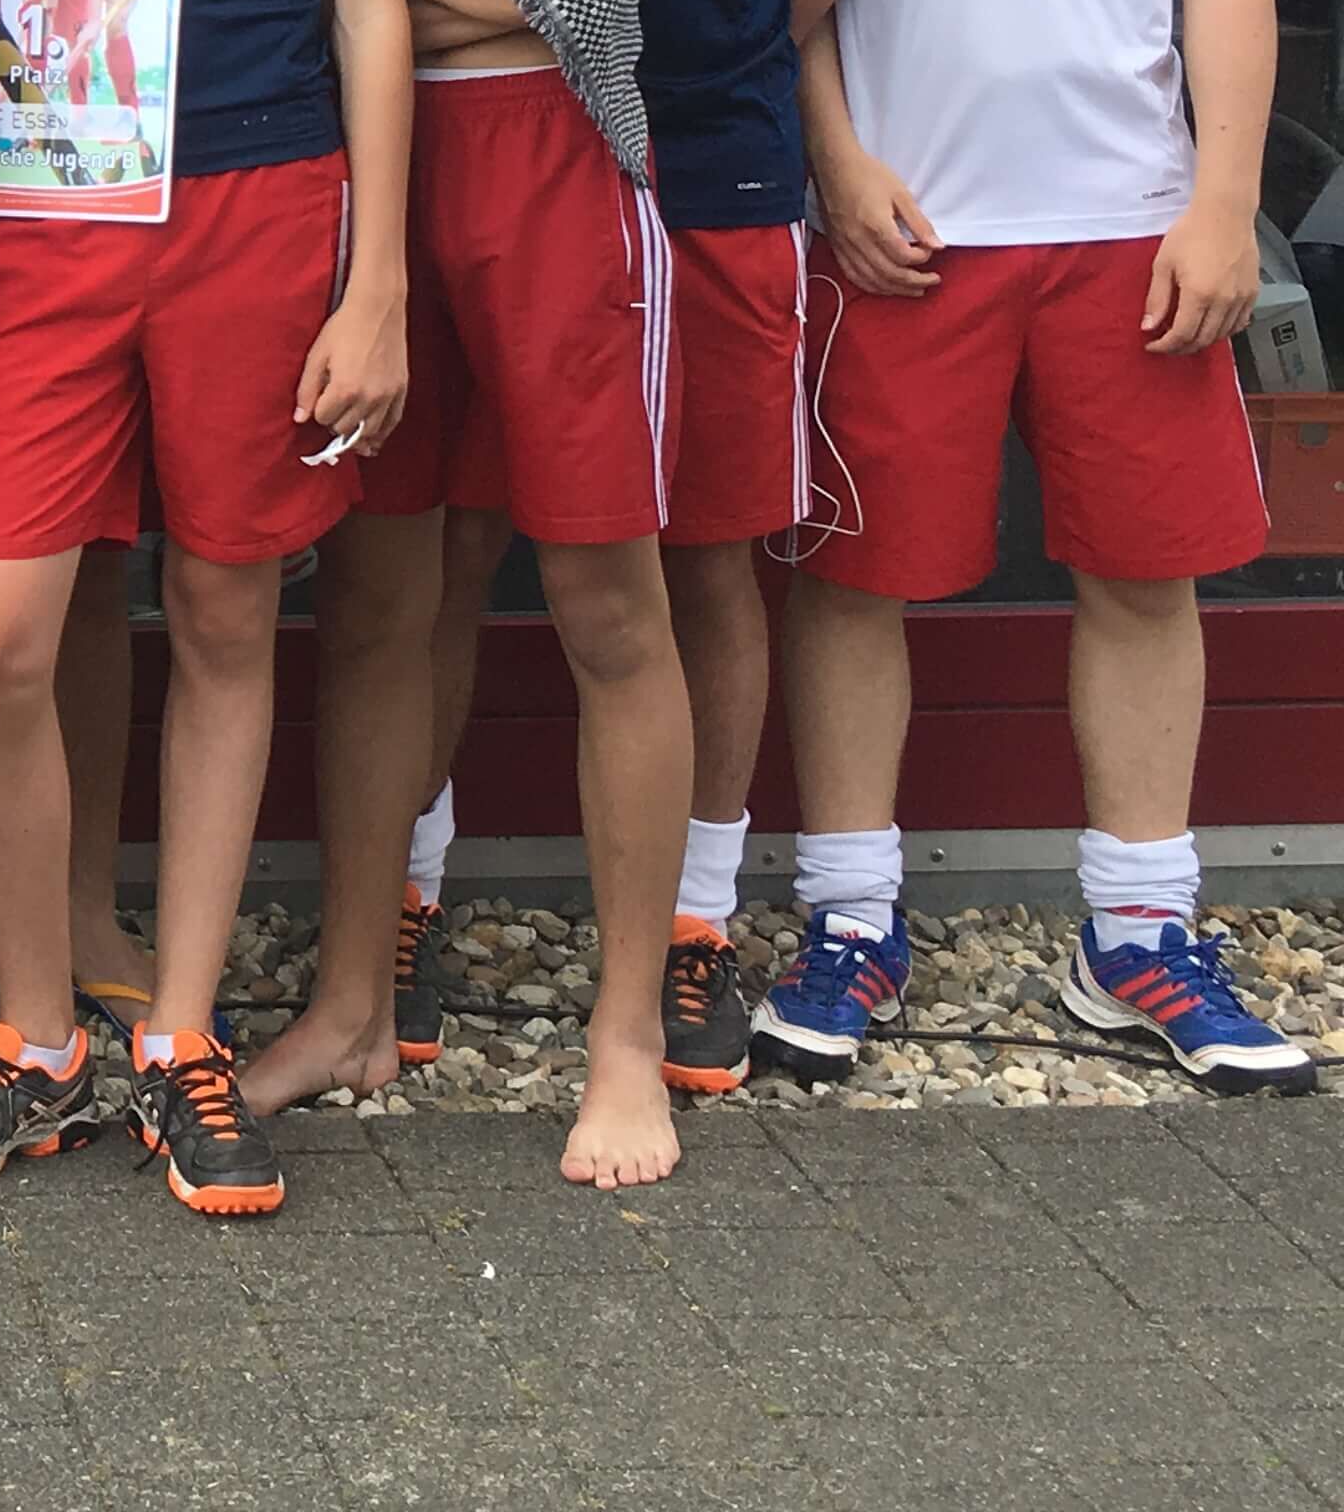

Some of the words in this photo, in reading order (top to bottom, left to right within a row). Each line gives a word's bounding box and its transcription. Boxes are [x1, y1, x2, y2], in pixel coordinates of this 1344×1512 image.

[19, 0, 68, 59] 1.
[12, 108, 69, 129] ESSEN
[41, 149, 116, 169] Jugend
[123, 152, 135, 167] B
